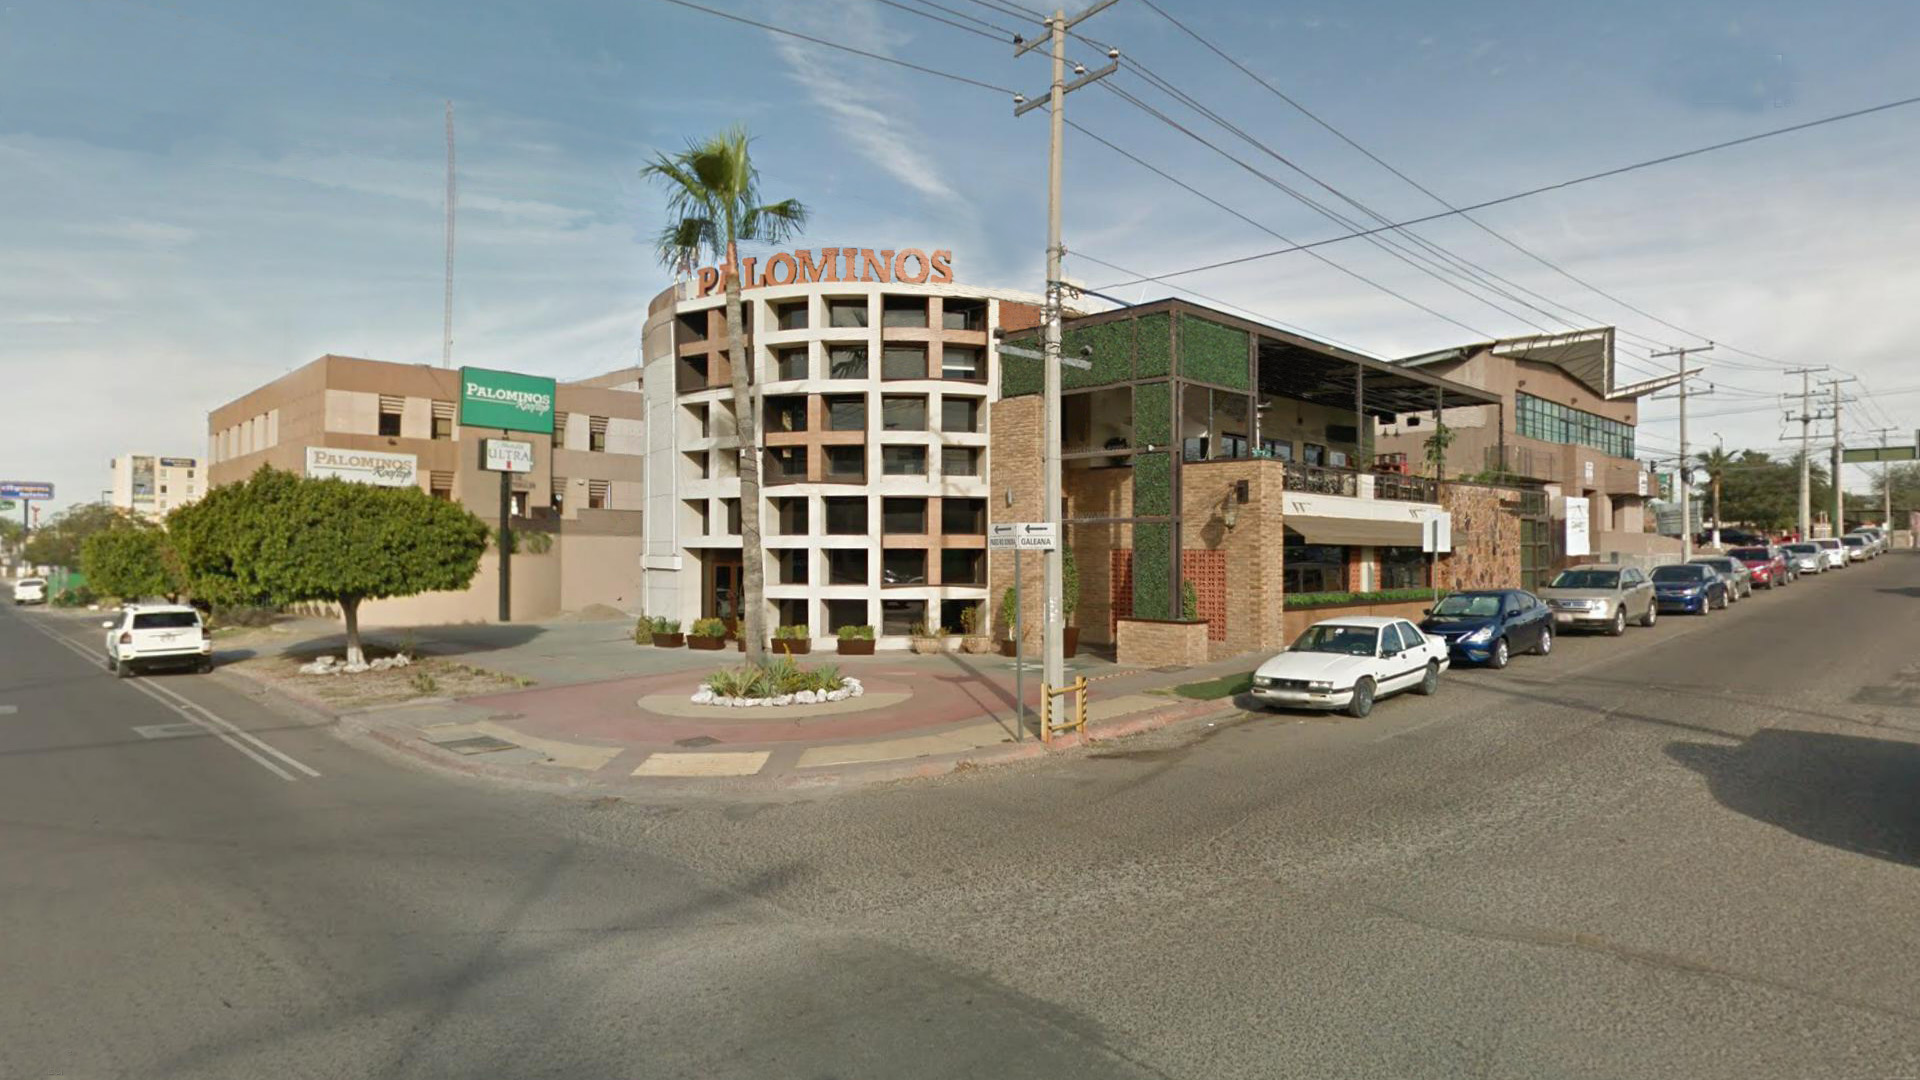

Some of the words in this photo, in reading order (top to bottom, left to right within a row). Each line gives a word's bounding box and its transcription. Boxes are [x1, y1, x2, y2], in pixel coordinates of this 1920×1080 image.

[466, 382, 550, 405] PALOMINOS
[313, 451, 412, 470] PALOMINOS
[488, 448, 529, 462] ULTRA
[1020, 537, 1052, 546] GALEANA
